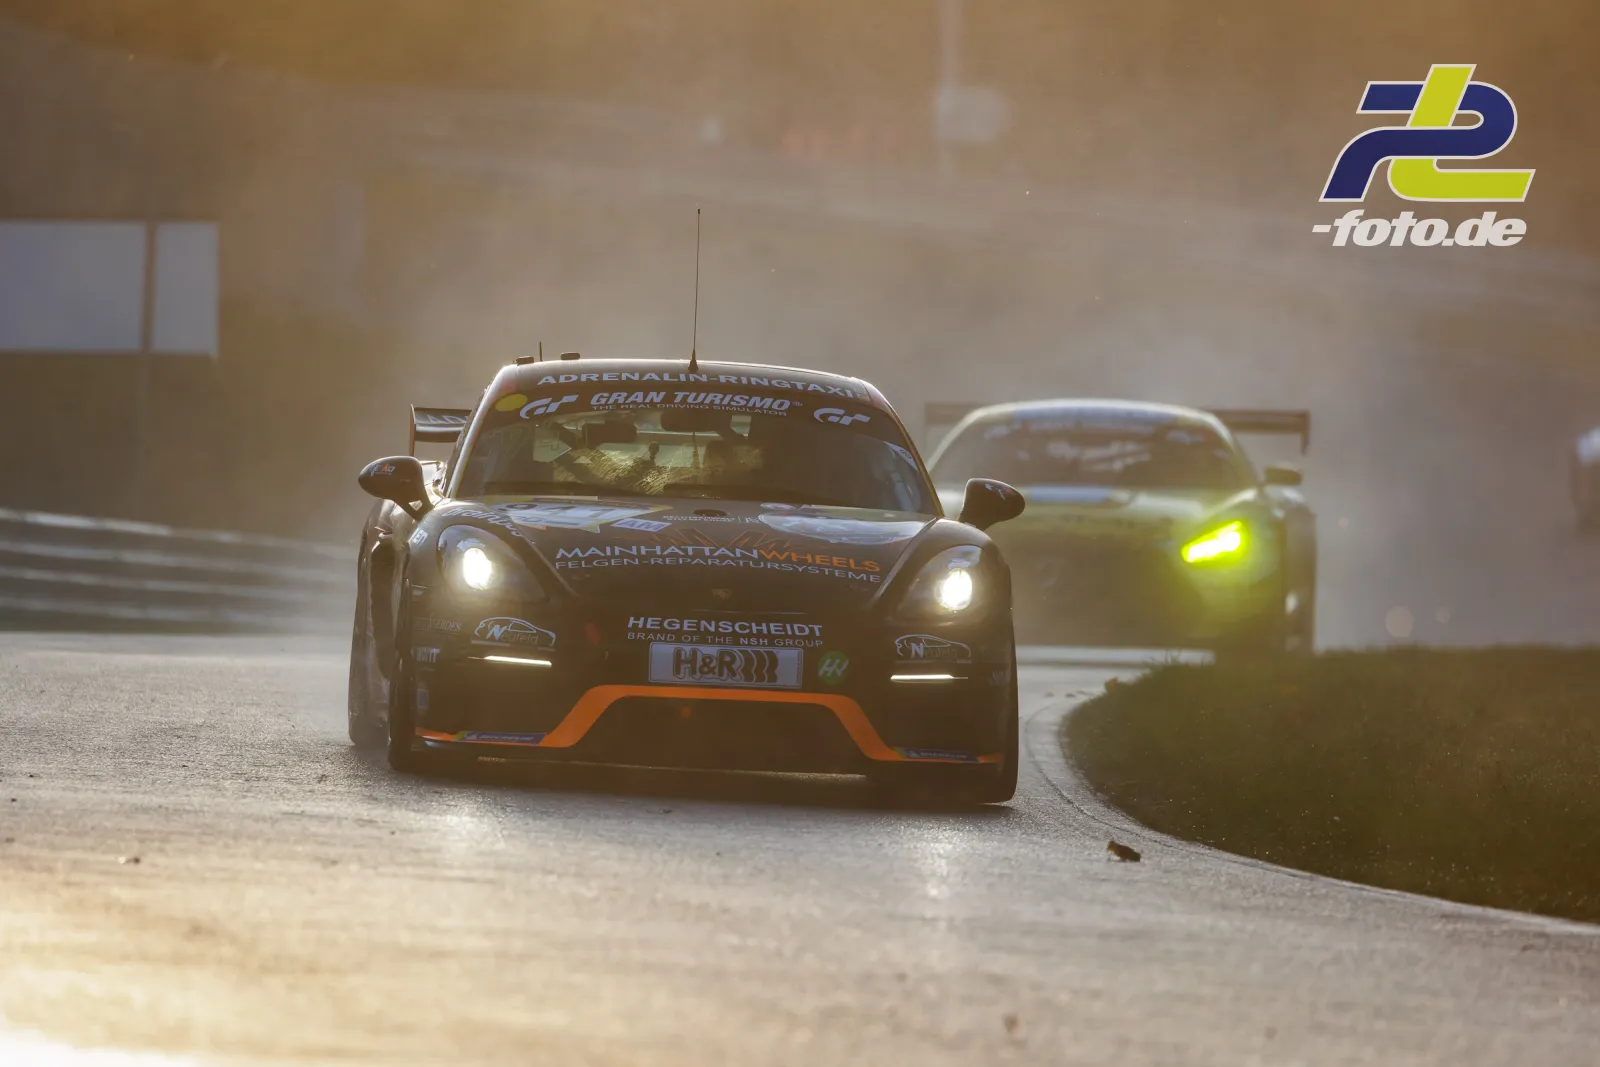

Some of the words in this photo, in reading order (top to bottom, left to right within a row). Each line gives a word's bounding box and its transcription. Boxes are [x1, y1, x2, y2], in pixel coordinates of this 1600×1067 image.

[590, 391, 666, 405] GRAN
[673, 391, 791, 411] TURISMO
[712, 404, 787, 416] SIMULATOR
[555, 557, 881, 583] FELGEN-REPARATURSYSTEME
[627, 616, 823, 637] HEGENSCHEIDT
[627, 631, 676, 642] BRAND
[682, 633, 700, 643] OF
[707, 635, 733, 645] THE
[739, 637, 768, 646] NSH
[774, 638, 823, 648] GROUP
